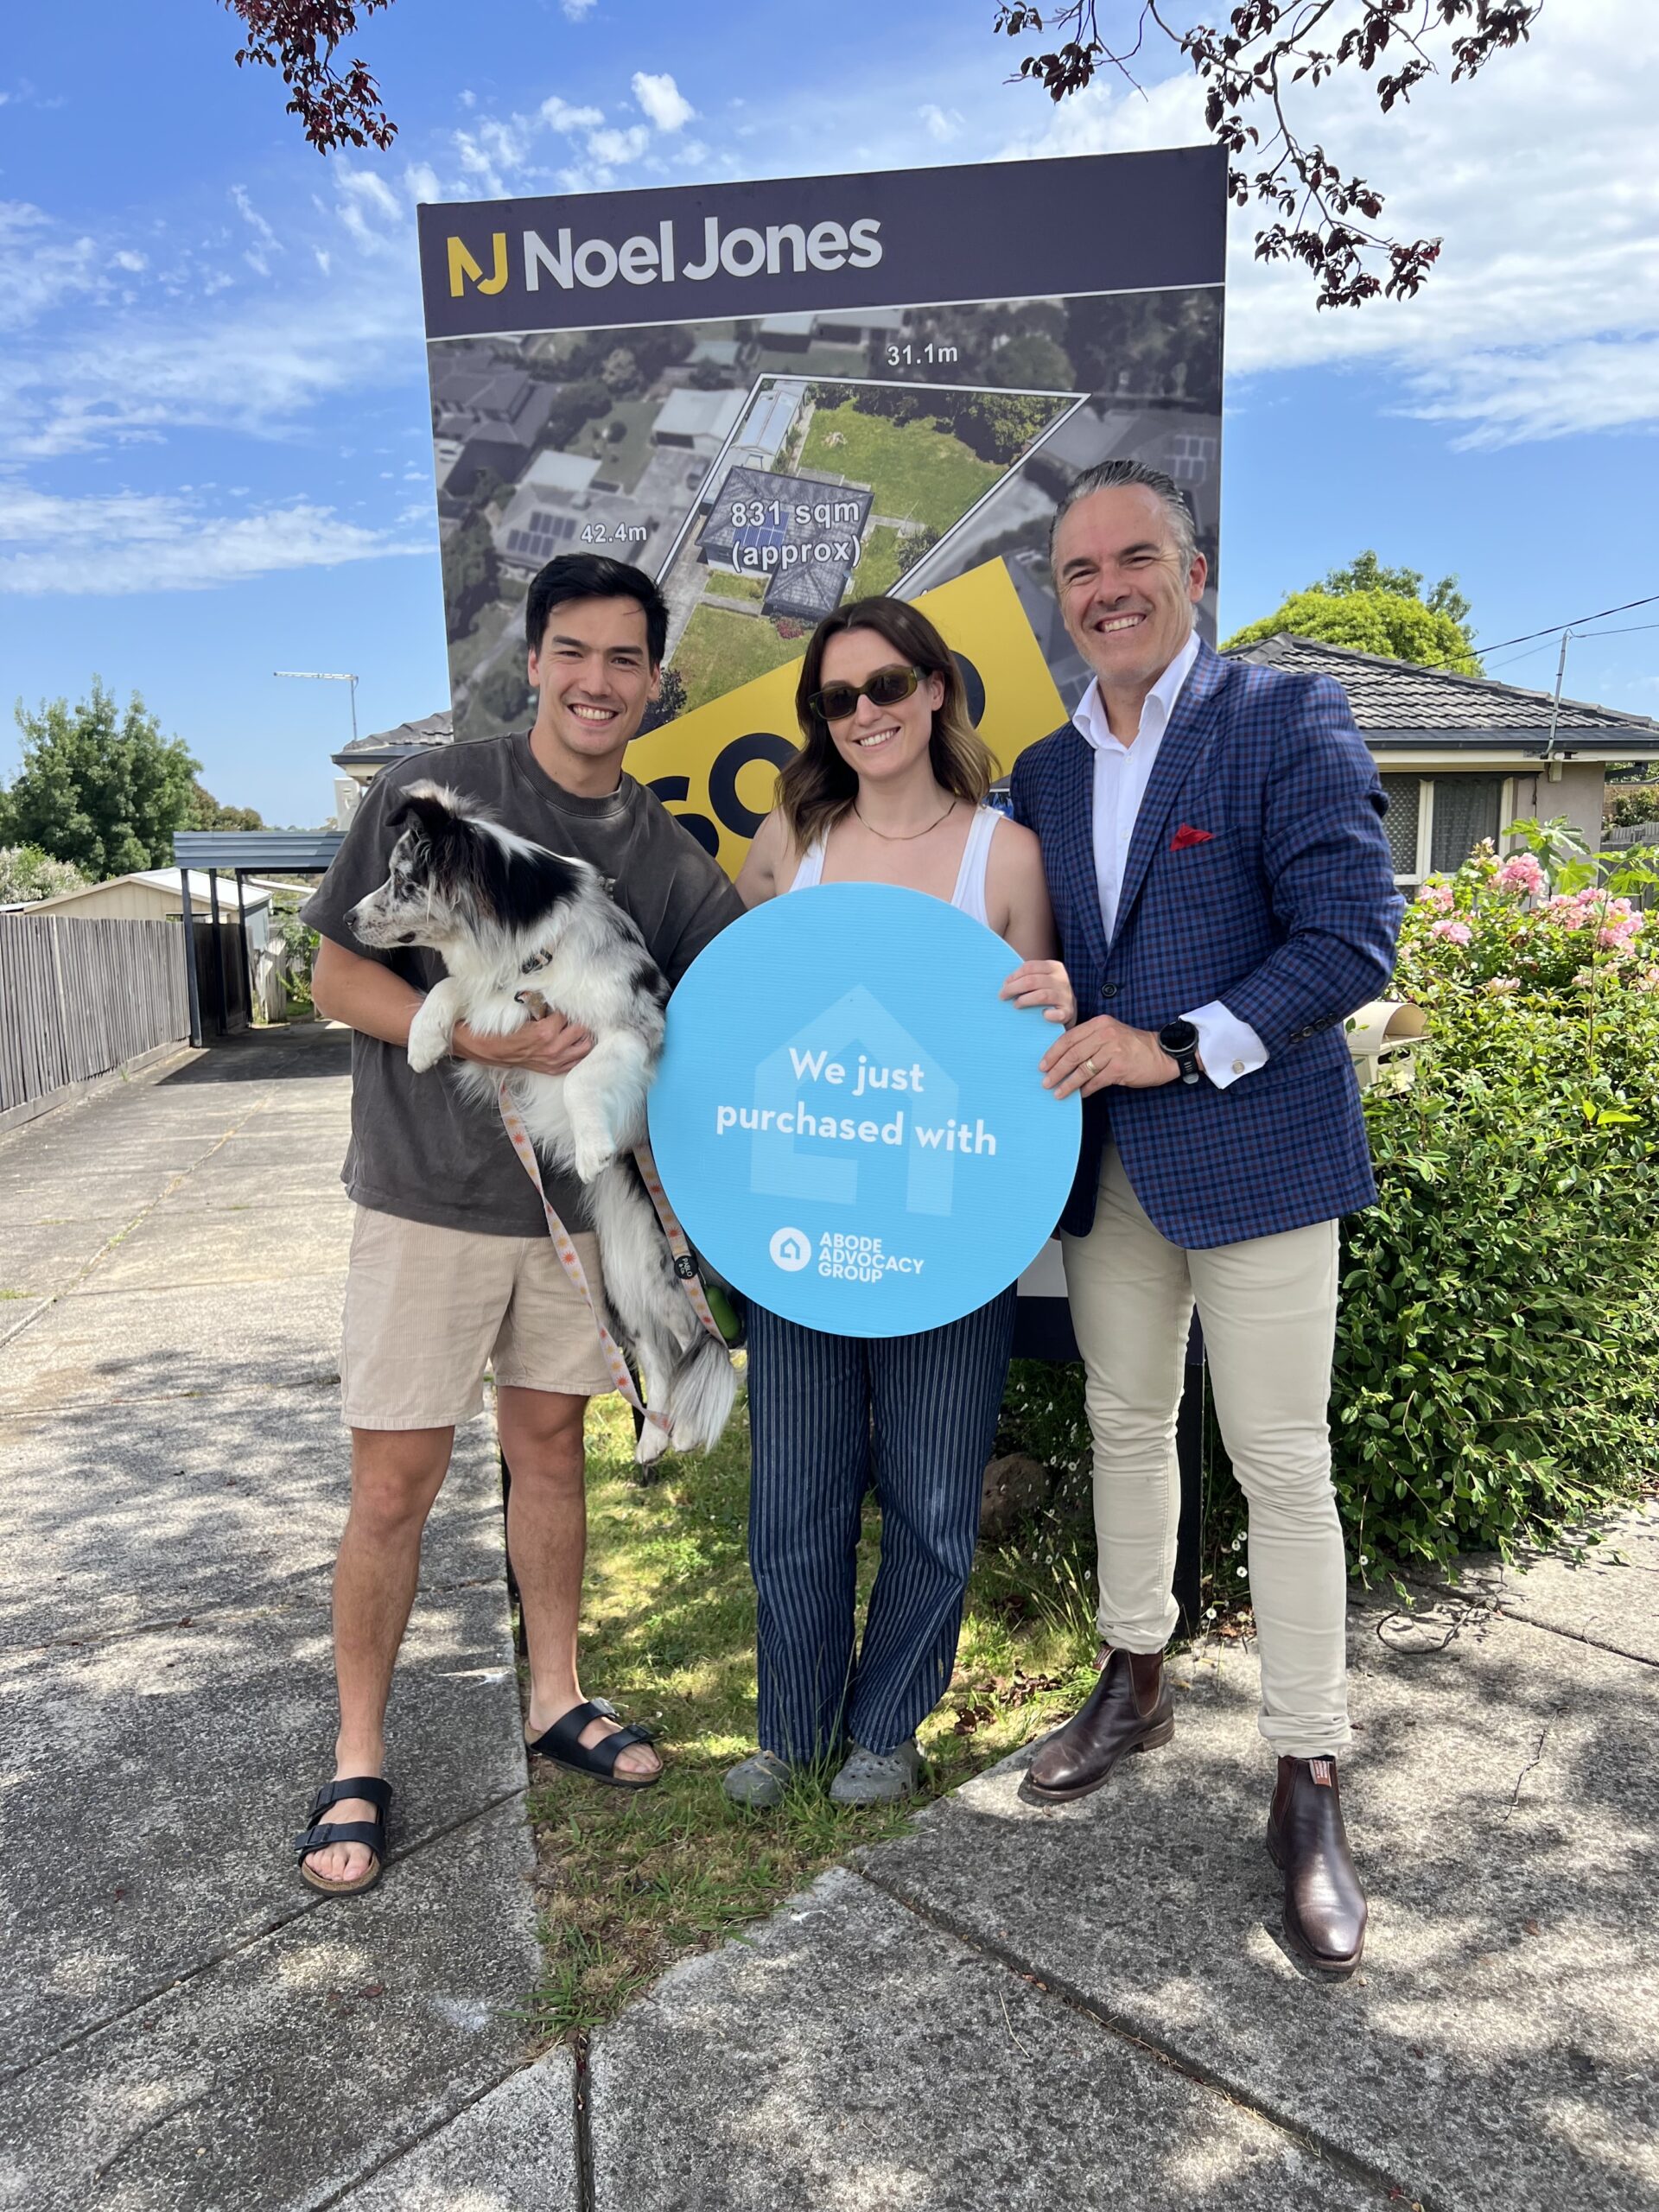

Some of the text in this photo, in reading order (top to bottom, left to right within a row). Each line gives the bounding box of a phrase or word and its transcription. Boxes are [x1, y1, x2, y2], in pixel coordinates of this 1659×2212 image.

[447, 216, 883, 297] NJ Noel Jones
[887, 343, 958, 366] 31.1m
[730, 500, 861, 530] 831 sqm
[581, 524, 648, 543] 42.4m
[732, 534, 862, 573] (approx)
[788, 1047, 925, 1096] We just
[715, 1101, 997, 1156] purchased with
[819, 1231, 883, 1254] ABODE
[817, 1247, 925, 1274] ADVOCACY
[817, 1262, 883, 1284] GROUP
